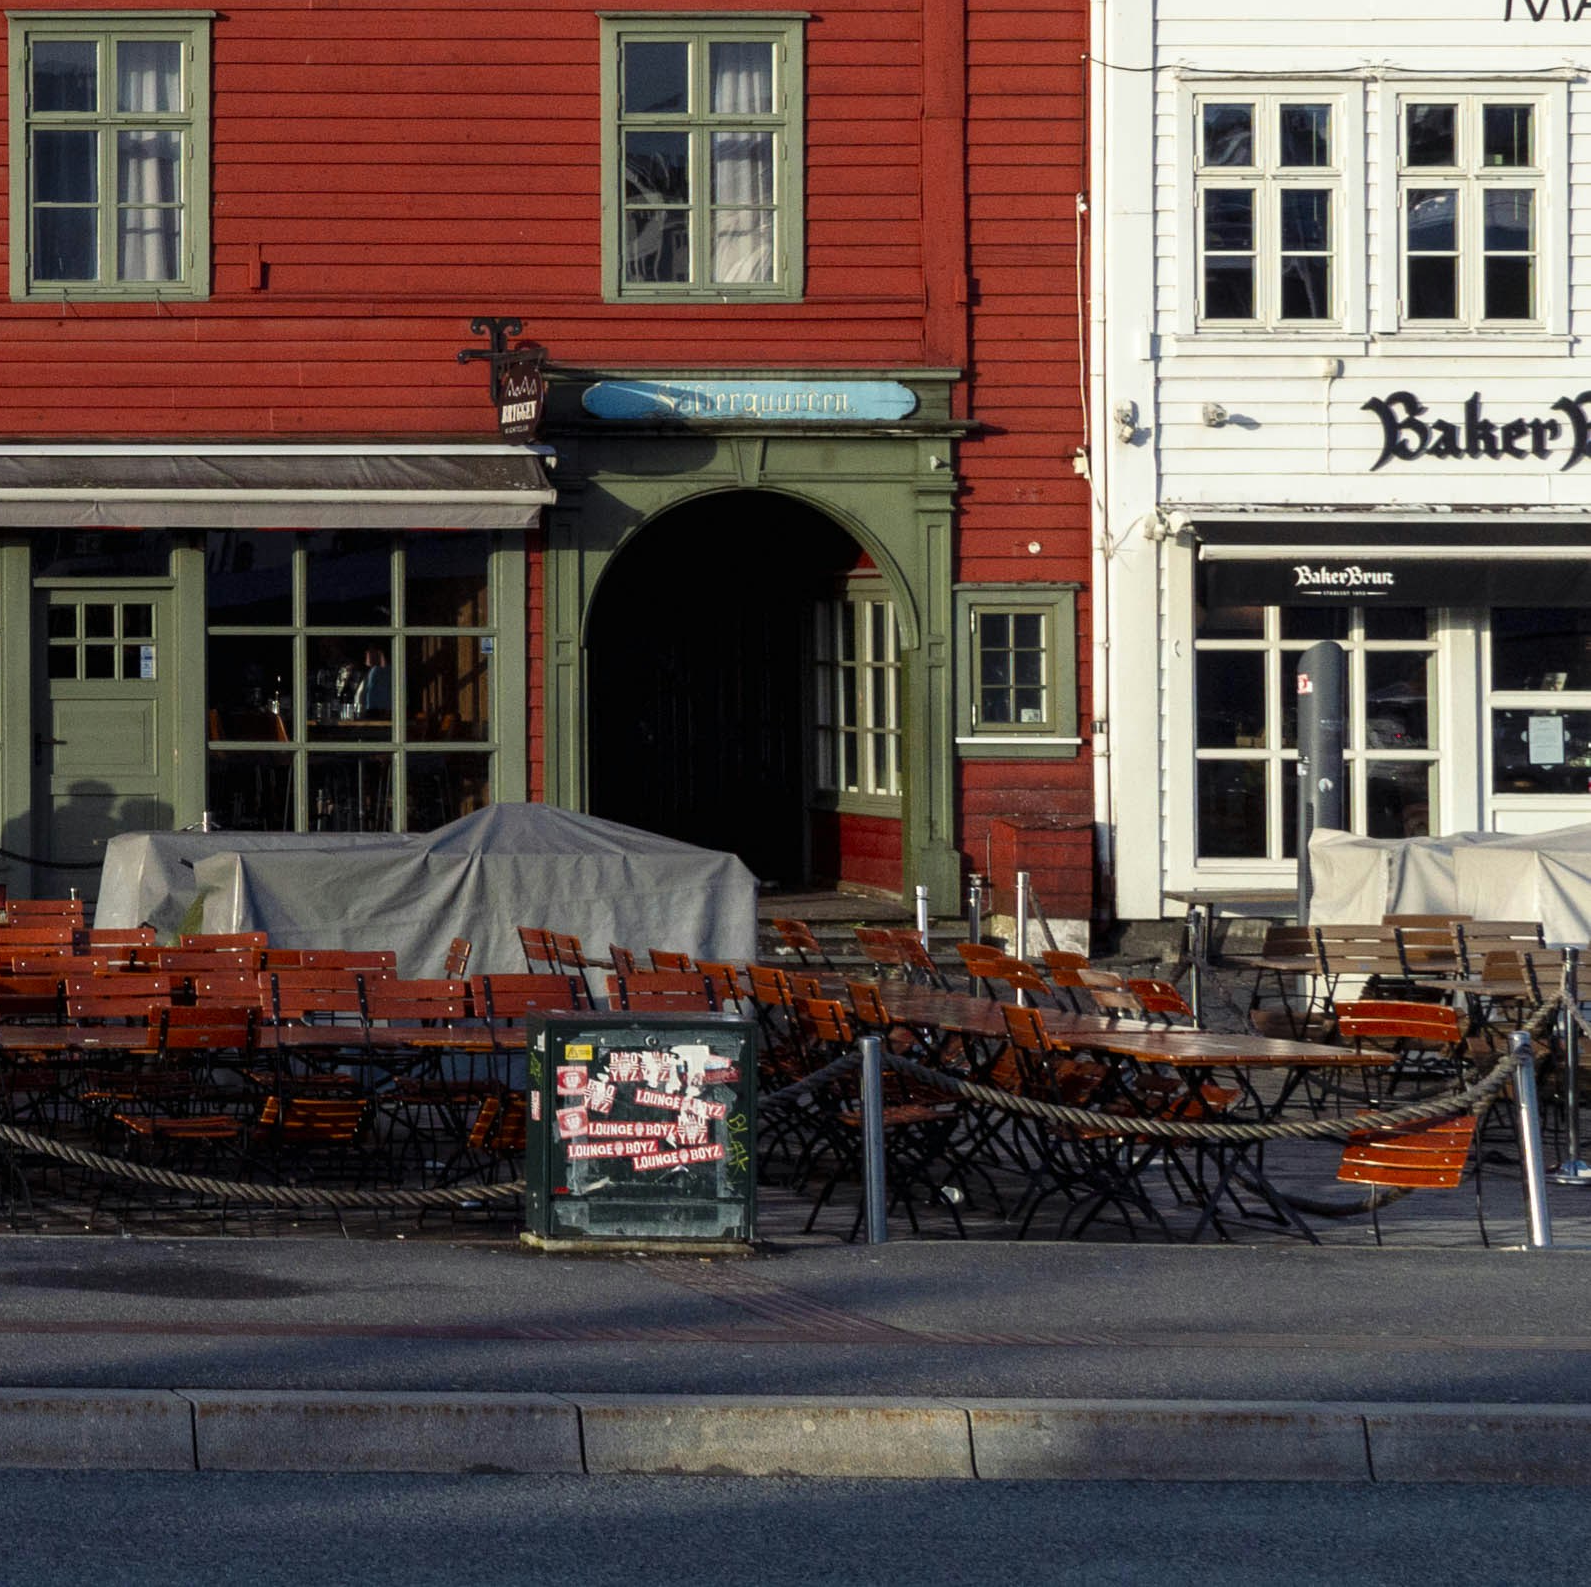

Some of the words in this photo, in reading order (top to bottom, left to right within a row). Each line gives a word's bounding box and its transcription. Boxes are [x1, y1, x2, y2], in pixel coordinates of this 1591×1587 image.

[636, 1090, 681, 1109] LOUNGE
[589, 1122, 634, 1136] LOUNGE
[645, 1123, 676, 1136] BOYZ
[568, 1143, 614, 1158] LOUNGE
[625, 1141, 657, 1154] BOYZ
[634, 1152, 679, 1170] LOUNGE
[690, 1144, 722, 1161] BOYZ
